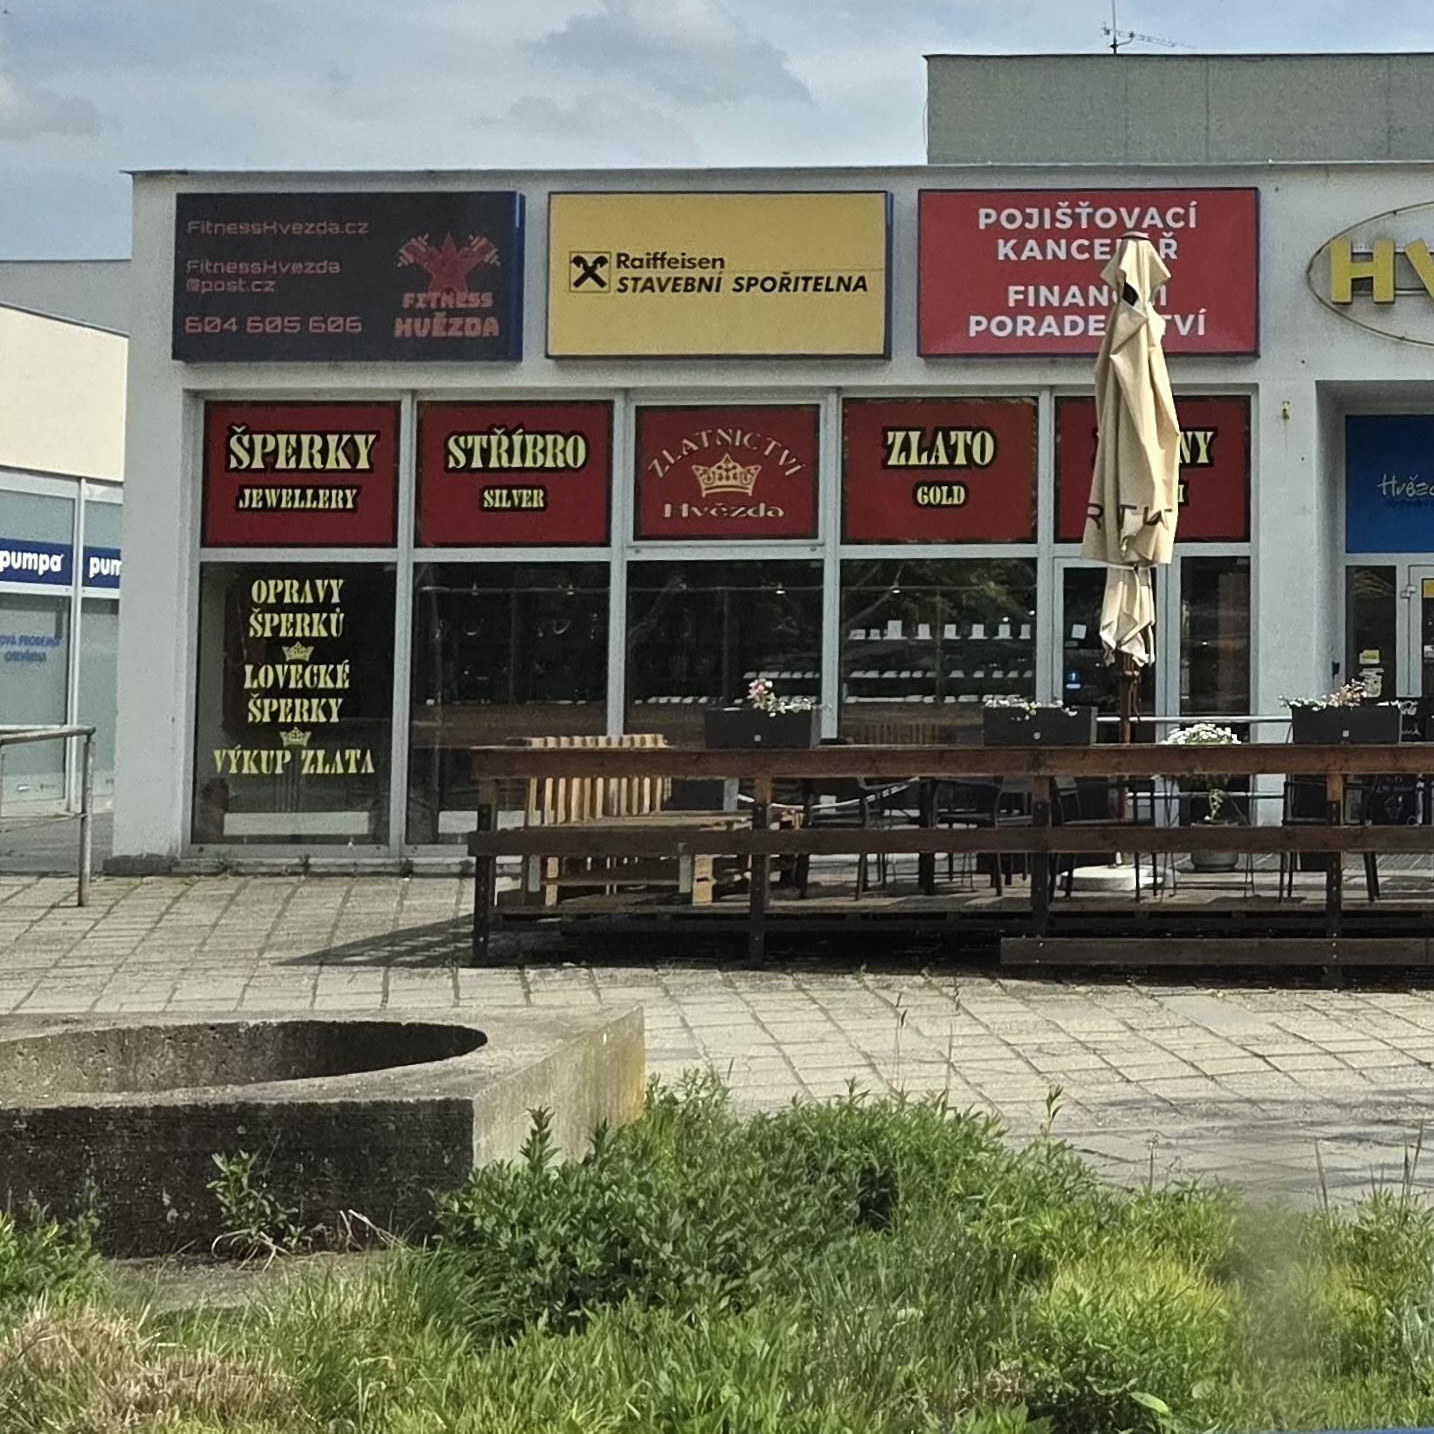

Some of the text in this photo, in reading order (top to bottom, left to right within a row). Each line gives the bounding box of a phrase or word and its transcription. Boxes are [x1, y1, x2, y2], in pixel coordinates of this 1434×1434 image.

[186, 221, 369, 235] FitnessHvezda.cz
[978, 201, 1198, 230] POJIŠŤOVACÍ
[997, 232, 1178, 261] KANCEŘ
[616, 252, 725, 269] Raiffeisen
[616, 272, 868, 293] STAVEBNÍ SPOŘITELNA
[402, 292, 493, 308] FITNESS
[309, 317, 362, 333] 606
[394, 312, 499, 338] HVĚZDA
[229, 425, 377, 470] ŠPERKY
[448, 428, 586, 469] STŘÍBRO
[648, 428, 806, 478] ZLATNICTVÍ
[887, 431, 995, 466] ZLATO
[238, 489, 357, 509] JEWELLERY
[483, 489, 544, 508] SILVER
[916, 486, 965, 505] GOLD
[664, 502, 784, 518] Hvězda
[251, 579, 343, 604] OPRAVY
[249, 607, 344, 638] ŠPERKŮ
[244, 659, 349, 689] LOVECKÉ
[248, 693, 343, 723] ŠPERKY
[213, 744, 375, 774] VÝKUP ZLATA
